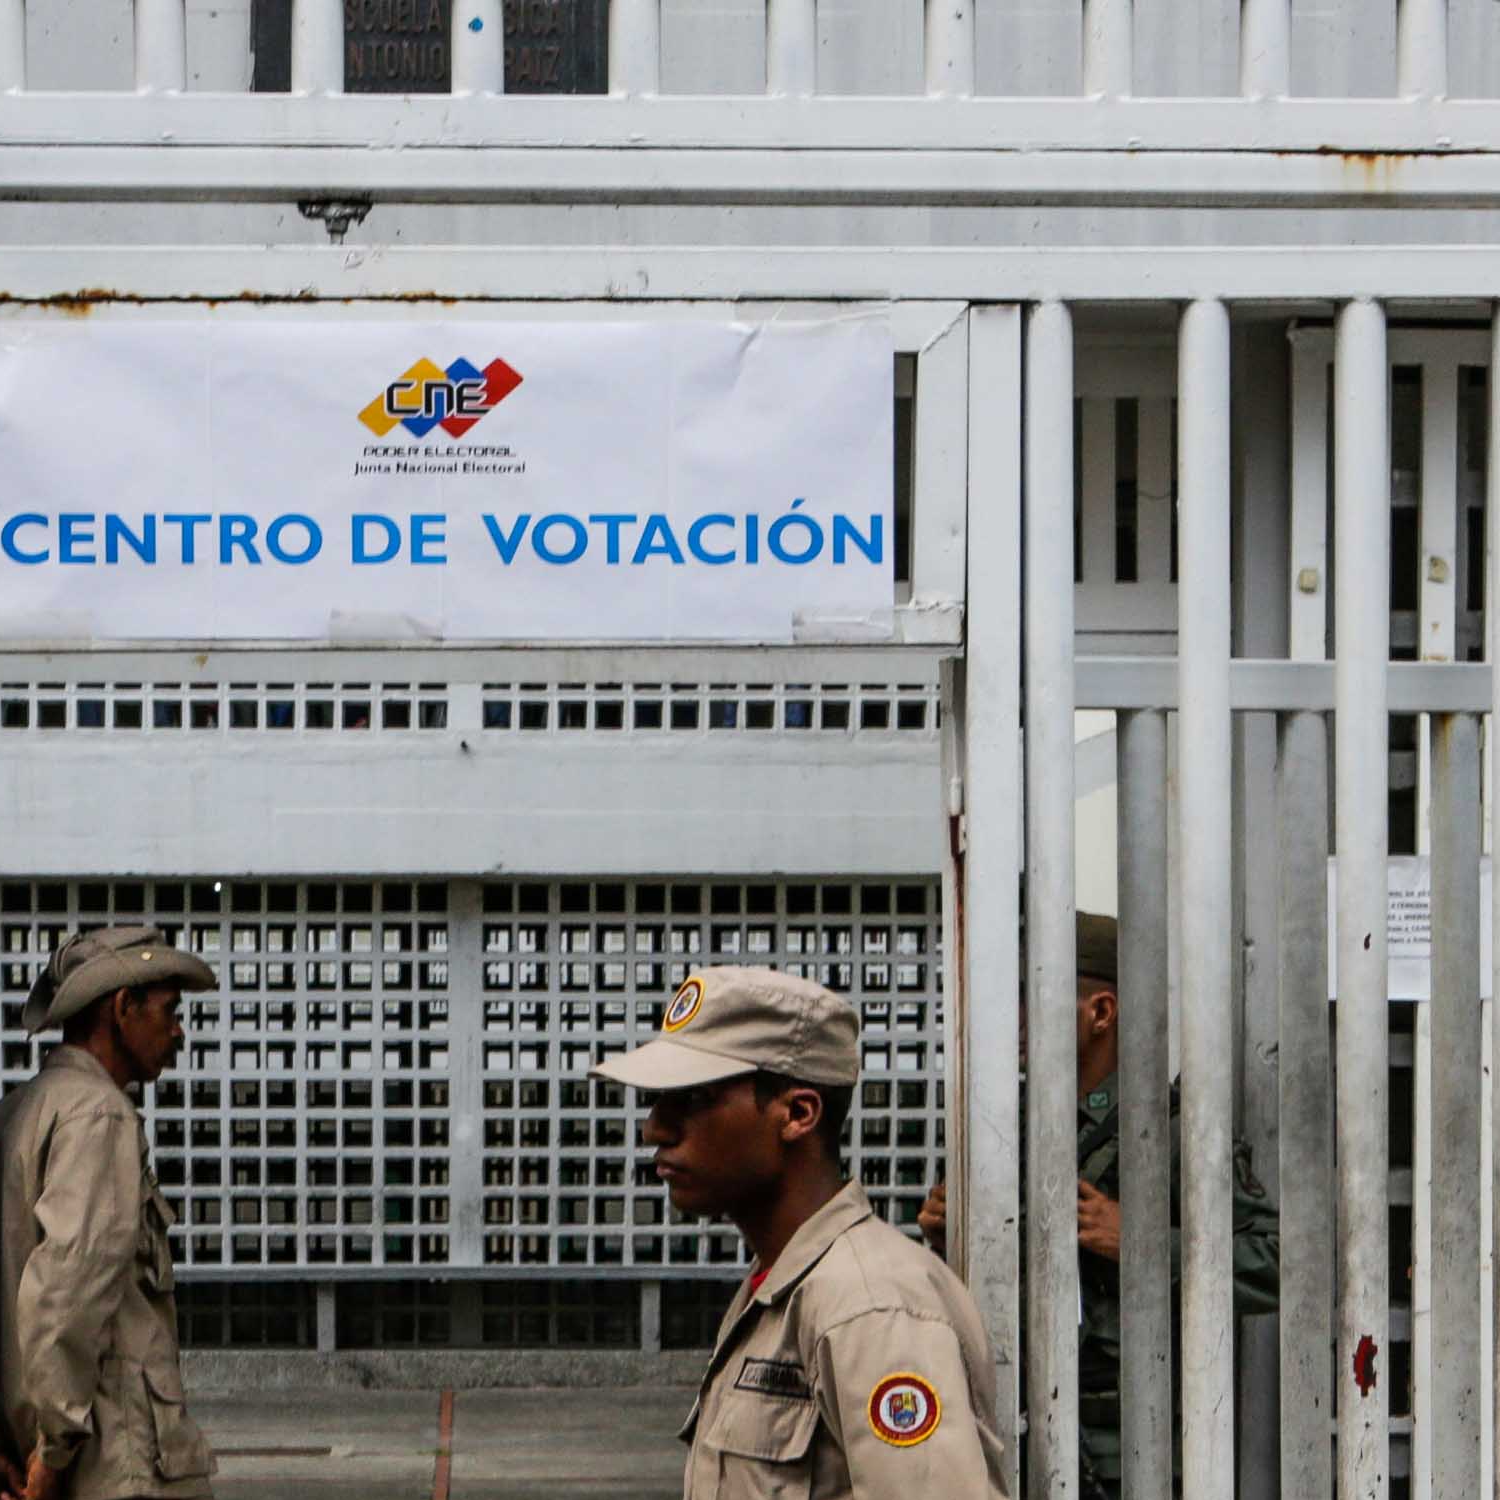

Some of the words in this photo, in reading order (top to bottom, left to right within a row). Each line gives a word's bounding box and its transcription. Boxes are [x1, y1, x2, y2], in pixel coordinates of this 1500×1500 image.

[345, 0, 443, 32] SCUELA
[348, 39, 447, 81] NTONIO
[385, 379, 491, 417] CNE
[354, 461, 391, 476] Junta
[396, 461, 458, 474] Nacional
[462, 461, 526, 474] Electoral
[363, 446, 420, 458] PODER
[424, 446, 517, 458] ELECTORAL
[0, 512, 323, 566] CENTRO
[352, 513, 448, 565] DE
[484, 498, 884, 566] VOTACIÓN
